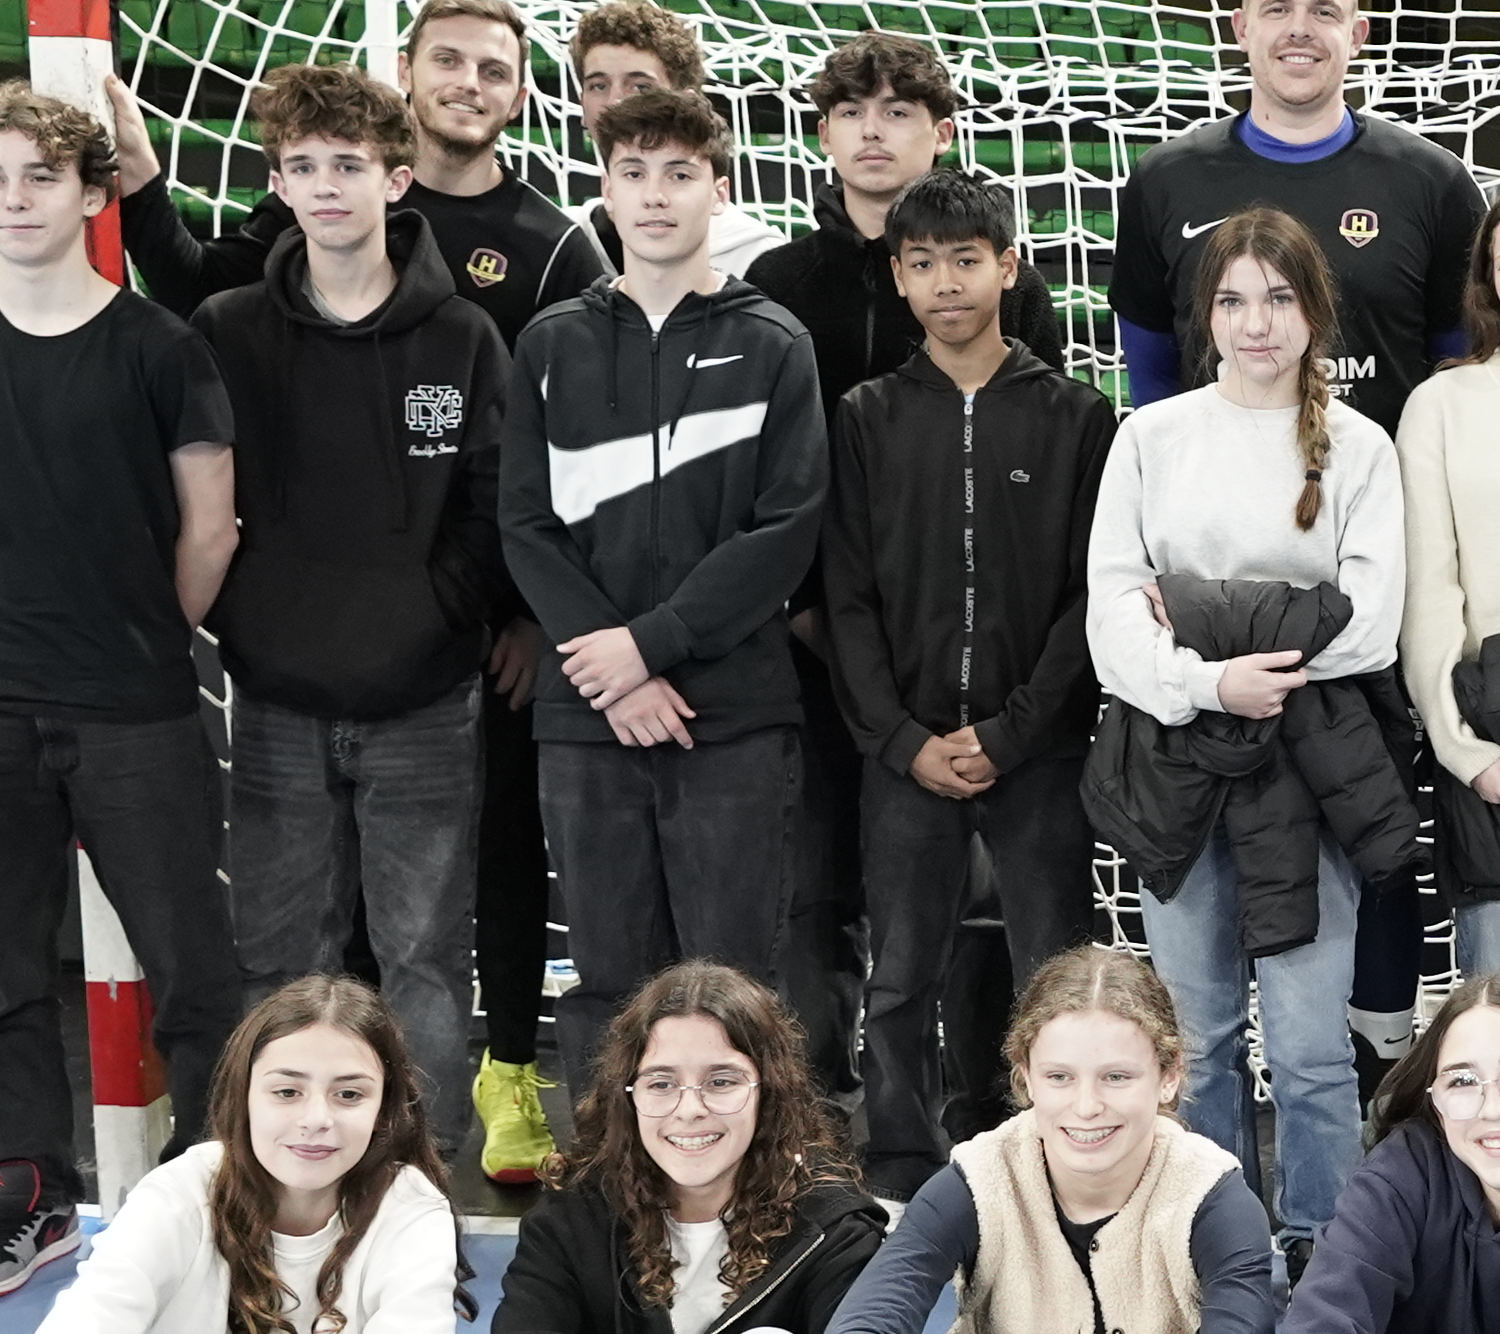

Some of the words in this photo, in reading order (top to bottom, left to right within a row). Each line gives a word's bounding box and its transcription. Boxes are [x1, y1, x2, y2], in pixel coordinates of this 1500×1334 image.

[1351, 215, 1367, 231] H
[479, 254, 497, 273] H
[964, 468, 974, 514] LACOSTE
[964, 528, 975, 572] LACOSTE
[964, 587, 975, 633] LACOSTE
[960, 646, 972, 691] LACOSTE
